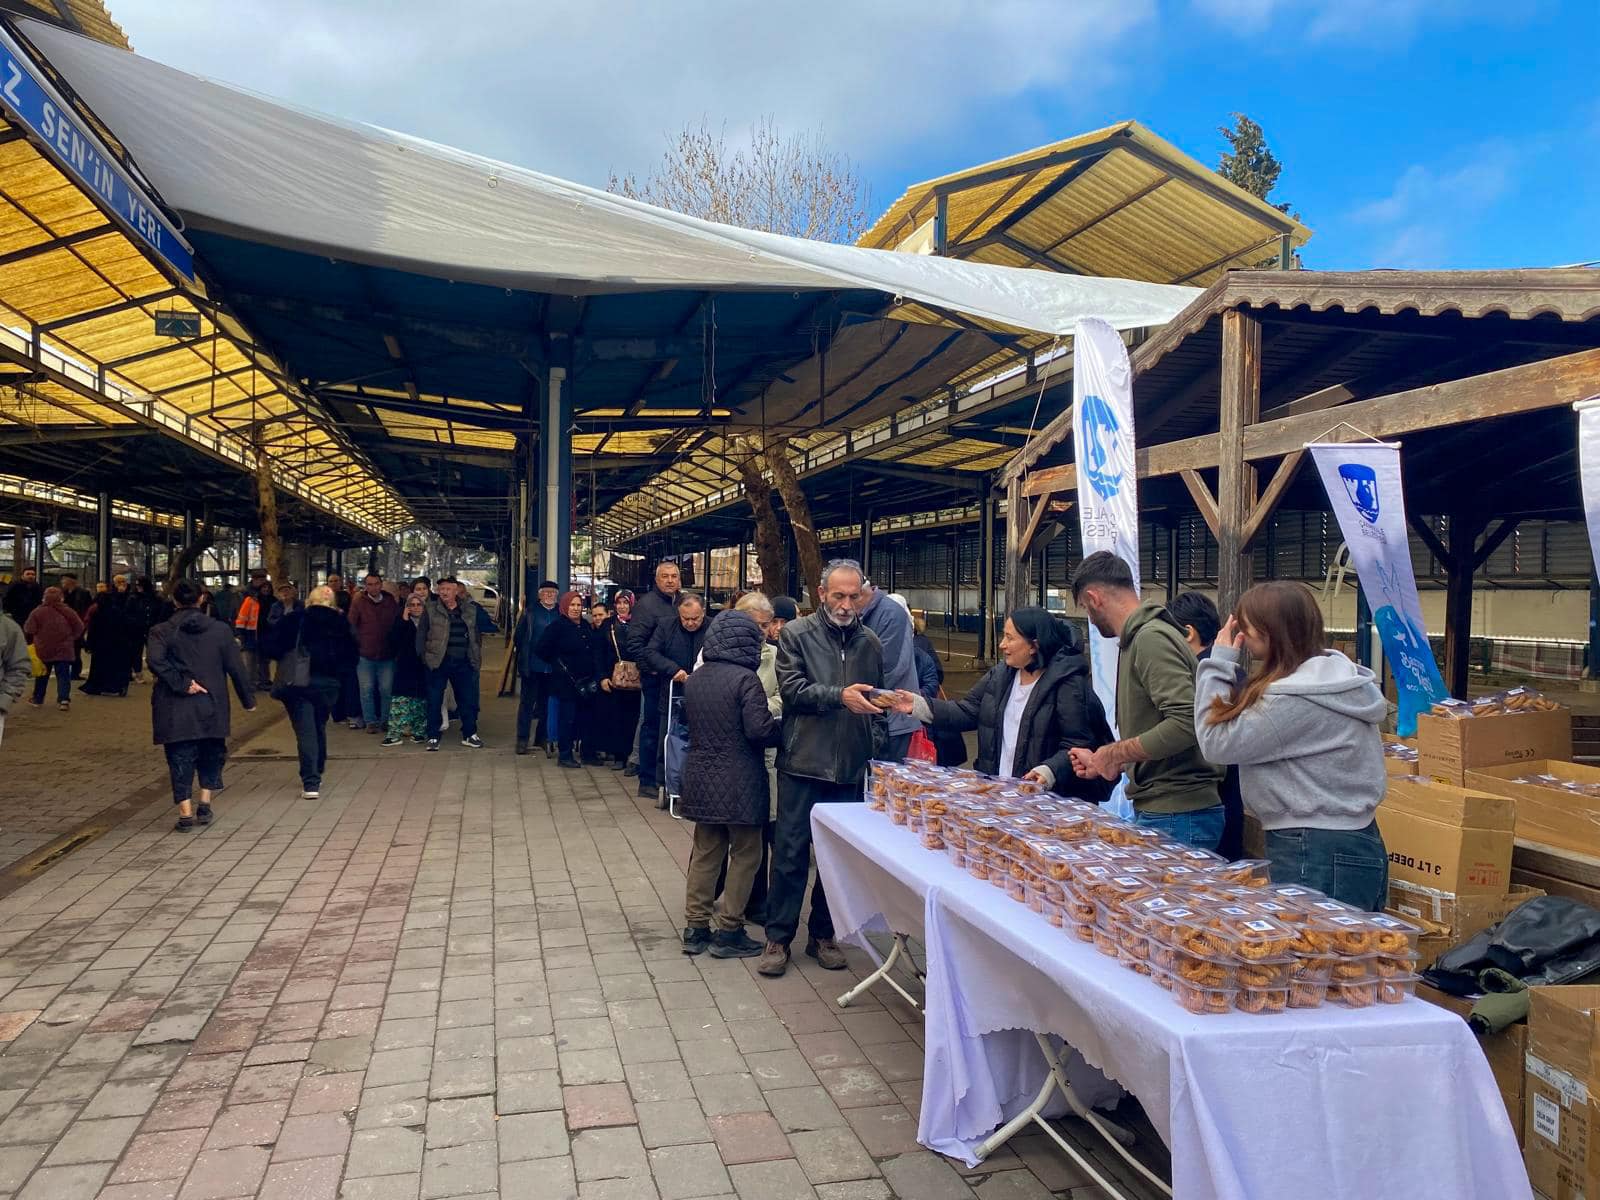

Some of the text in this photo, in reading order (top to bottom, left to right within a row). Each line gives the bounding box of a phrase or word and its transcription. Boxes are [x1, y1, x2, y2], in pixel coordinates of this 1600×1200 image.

[0, 59, 22, 107] Z
[1417, 860, 1432, 873] LT
[1434, 864, 1442, 876] 3
